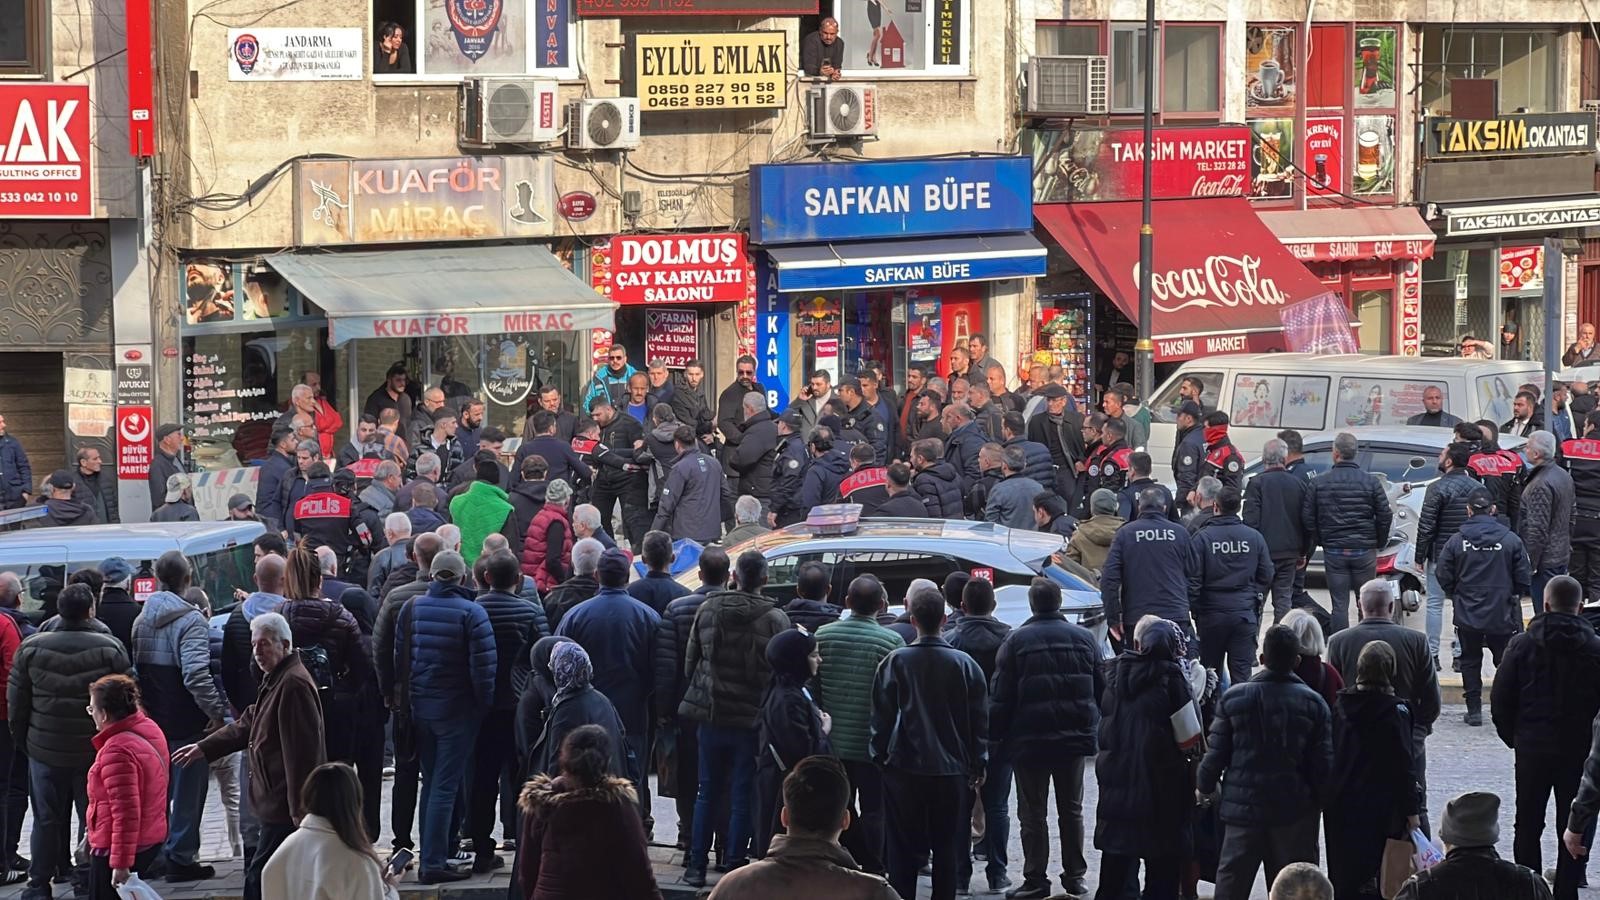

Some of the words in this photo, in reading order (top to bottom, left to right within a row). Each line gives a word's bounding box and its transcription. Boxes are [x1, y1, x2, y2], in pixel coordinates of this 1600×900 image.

[285, 36, 332, 47] JANDARMA
[642, 40, 706, 76] EYLÜL
[713, 45, 782, 75] EMLAK
[649, 84, 689, 95] 0850
[695, 84, 724, 94] 227
[731, 83, 750, 92] 90
[756, 82, 775, 91] 58
[648, 97, 689, 107] 0462
[695, 95, 725, 106] 999
[732, 95, 749, 104] 11
[756, 95, 775, 104] 52
[864, 89, 872, 129] VESTEL
[543, 94, 551, 128] VESTEL
[0, 98, 81, 162] AK
[1437, 119, 1526, 152] TAKSİM
[1522, 124, 1588, 148] LOKANTASI
[1180, 140, 1246, 160] MARKET
[42, 169, 77, 177] OFFICE
[1213, 161, 1226, 170] 323
[1227, 161, 1236, 170] 28
[1237, 161, 1246, 170] 26
[353, 162, 500, 195] KUAFÖR
[24, 192, 44, 202] 042
[48, 192, 61, 202] 10
[65, 192, 78, 202] 10
[804, 187, 911, 217] SAFKAN
[924, 177, 991, 211] BÜFE
[370, 202, 485, 233] MİRAÇ
[1457, 213, 1515, 230] TAKSİM
[620, 238, 737, 267] DOLMUŞ
[615, 272, 660, 289] ÇAY
[655, 269, 742, 285] KAHVALTI
[865, 268, 925, 284] SAFKAN
[932, 262, 970, 279] BÜFE
[644, 286, 714, 302] SALONU
[373, 313, 469, 336] KUAFÖR
[503, 311, 574, 333] MİRAÇ
[661, 313, 693, 323] FARAN
[648, 334, 664, 342] HAC
[666, 334, 671, 342] &
[673, 335, 695, 343] UMRE
[1159, 338, 1194, 357] TAKSİM
[1207, 335, 1247, 353] MARKET
[119, 380, 151, 389] AVUKAT
[122, 445, 148, 454] BÜYÜK
[122, 454, 148, 464] BİRLİK
[120, 464, 150, 474] PARTİSİ
[137, 581, 153, 592] 112
